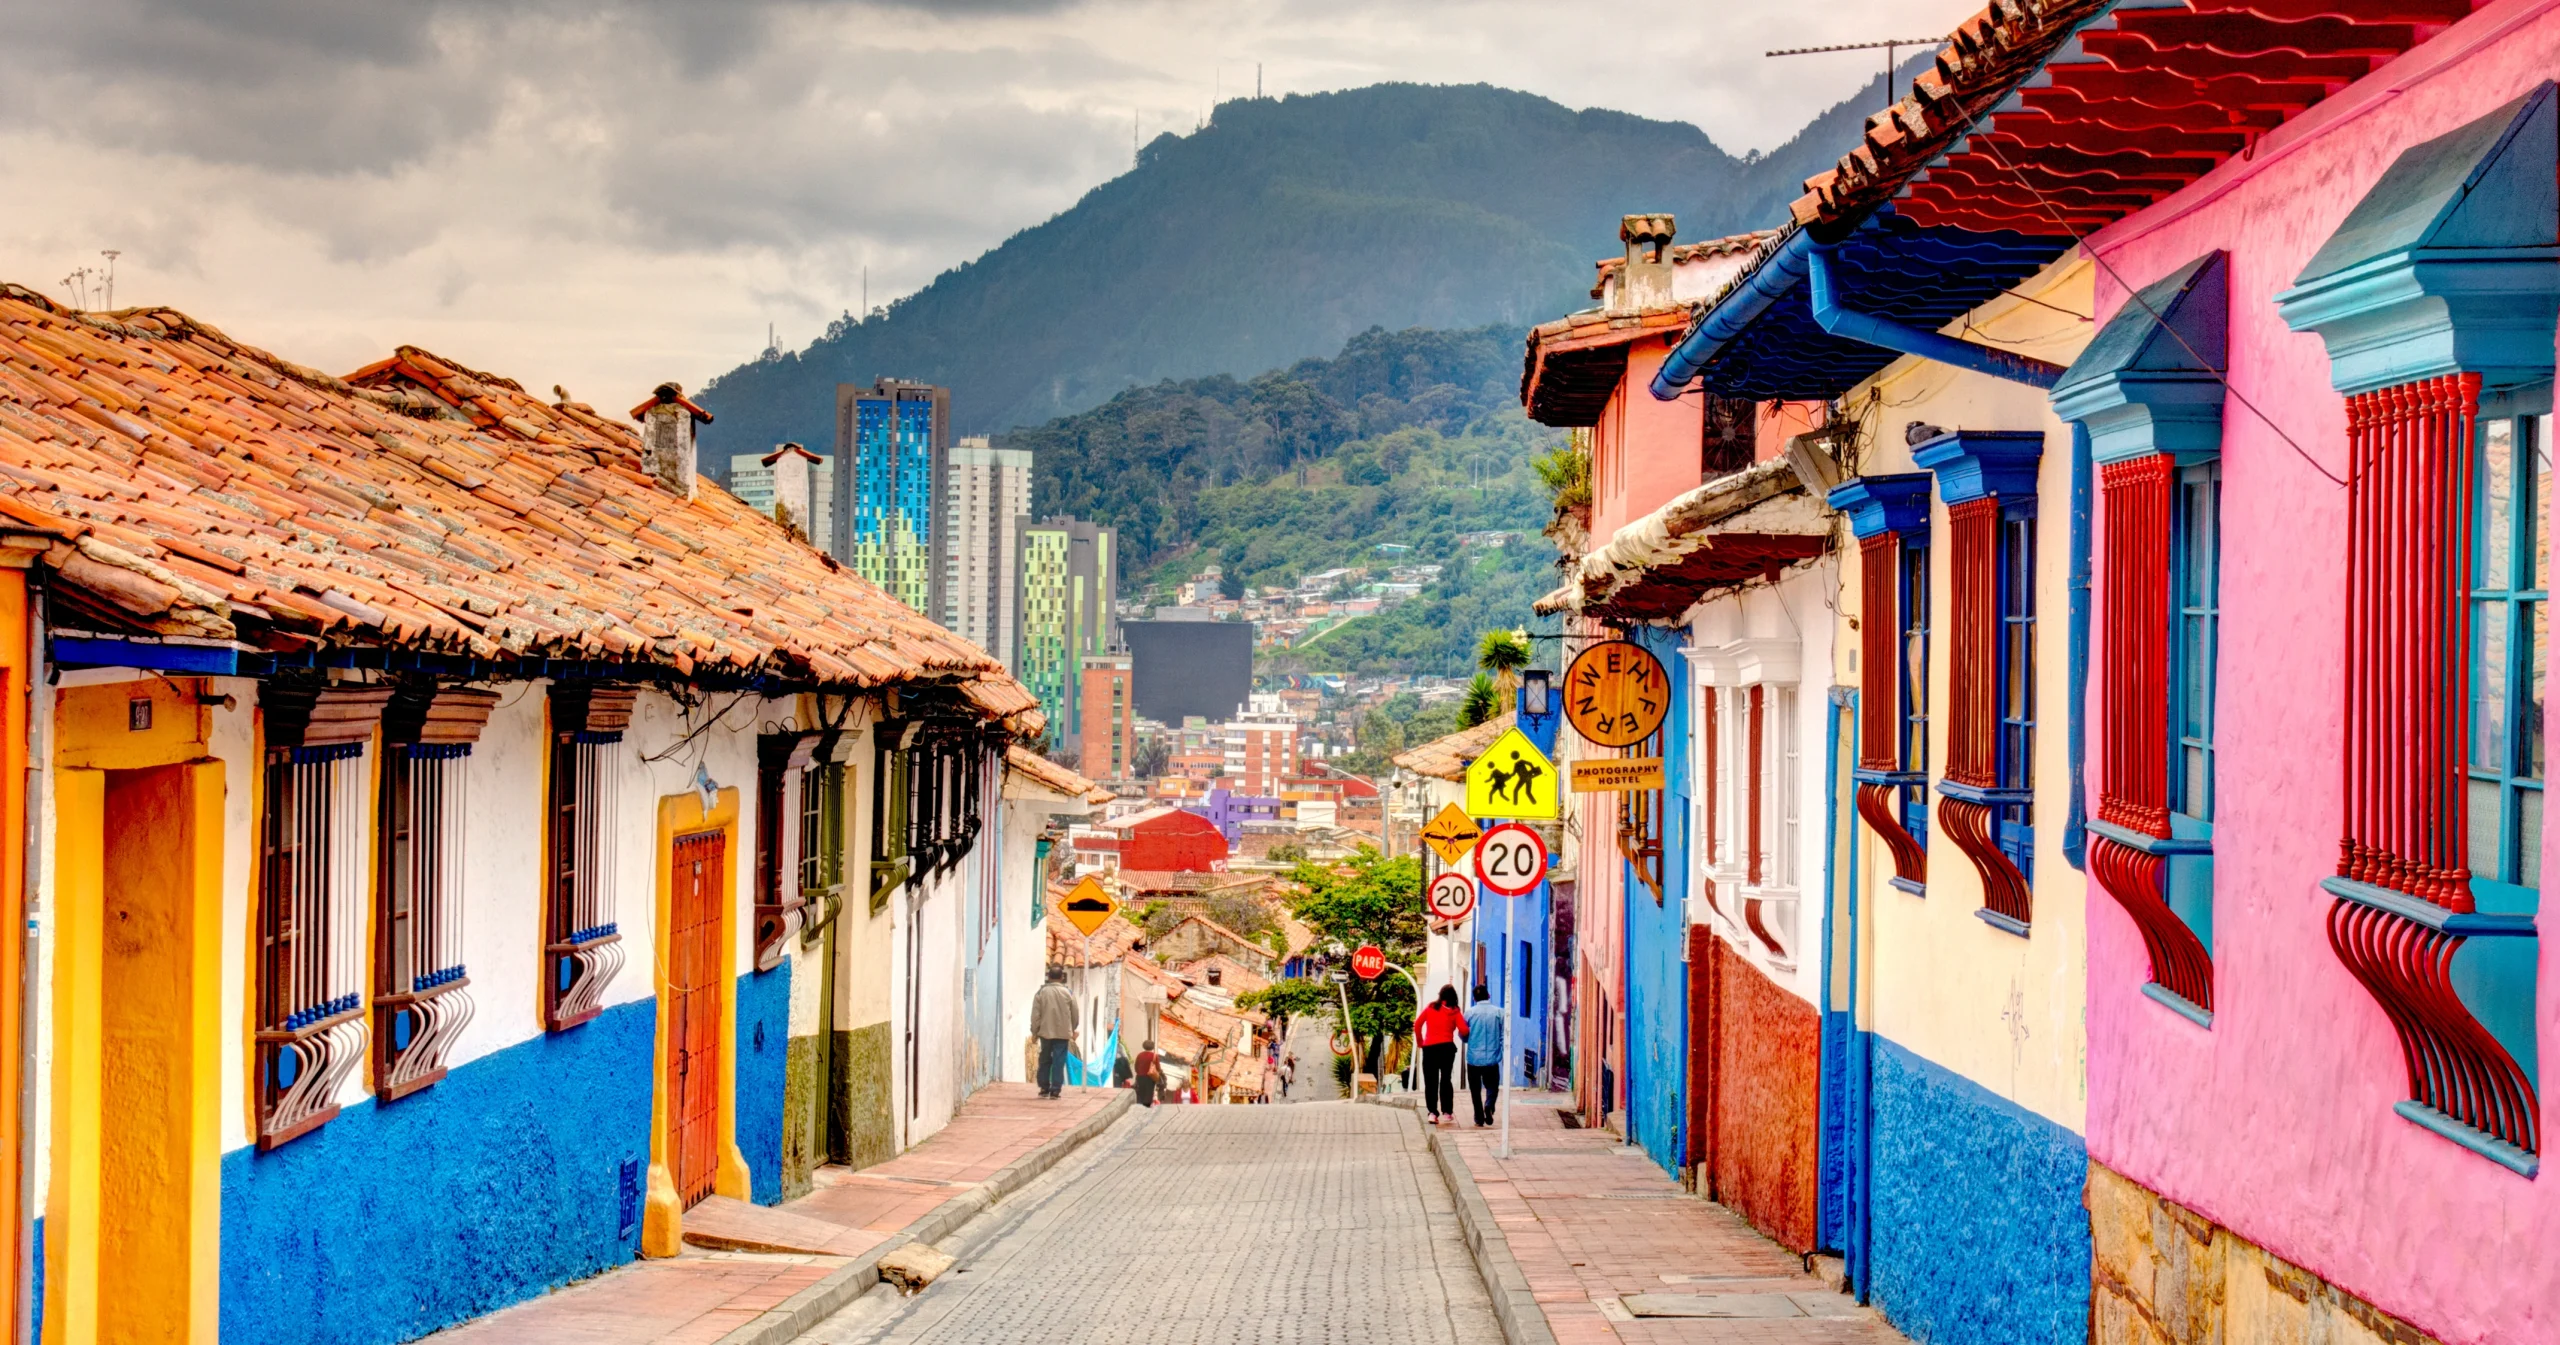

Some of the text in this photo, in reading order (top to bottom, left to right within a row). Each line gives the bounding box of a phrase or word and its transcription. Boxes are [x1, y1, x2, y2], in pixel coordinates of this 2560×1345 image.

[1577, 765, 1658, 775] PHOTOGRAPHY
[1598, 776, 1640, 785] HOSTEL
[1489, 842, 1534, 877] 20
[1435, 885, 1466, 907] 20
[1355, 954, 1382, 970] PARE
